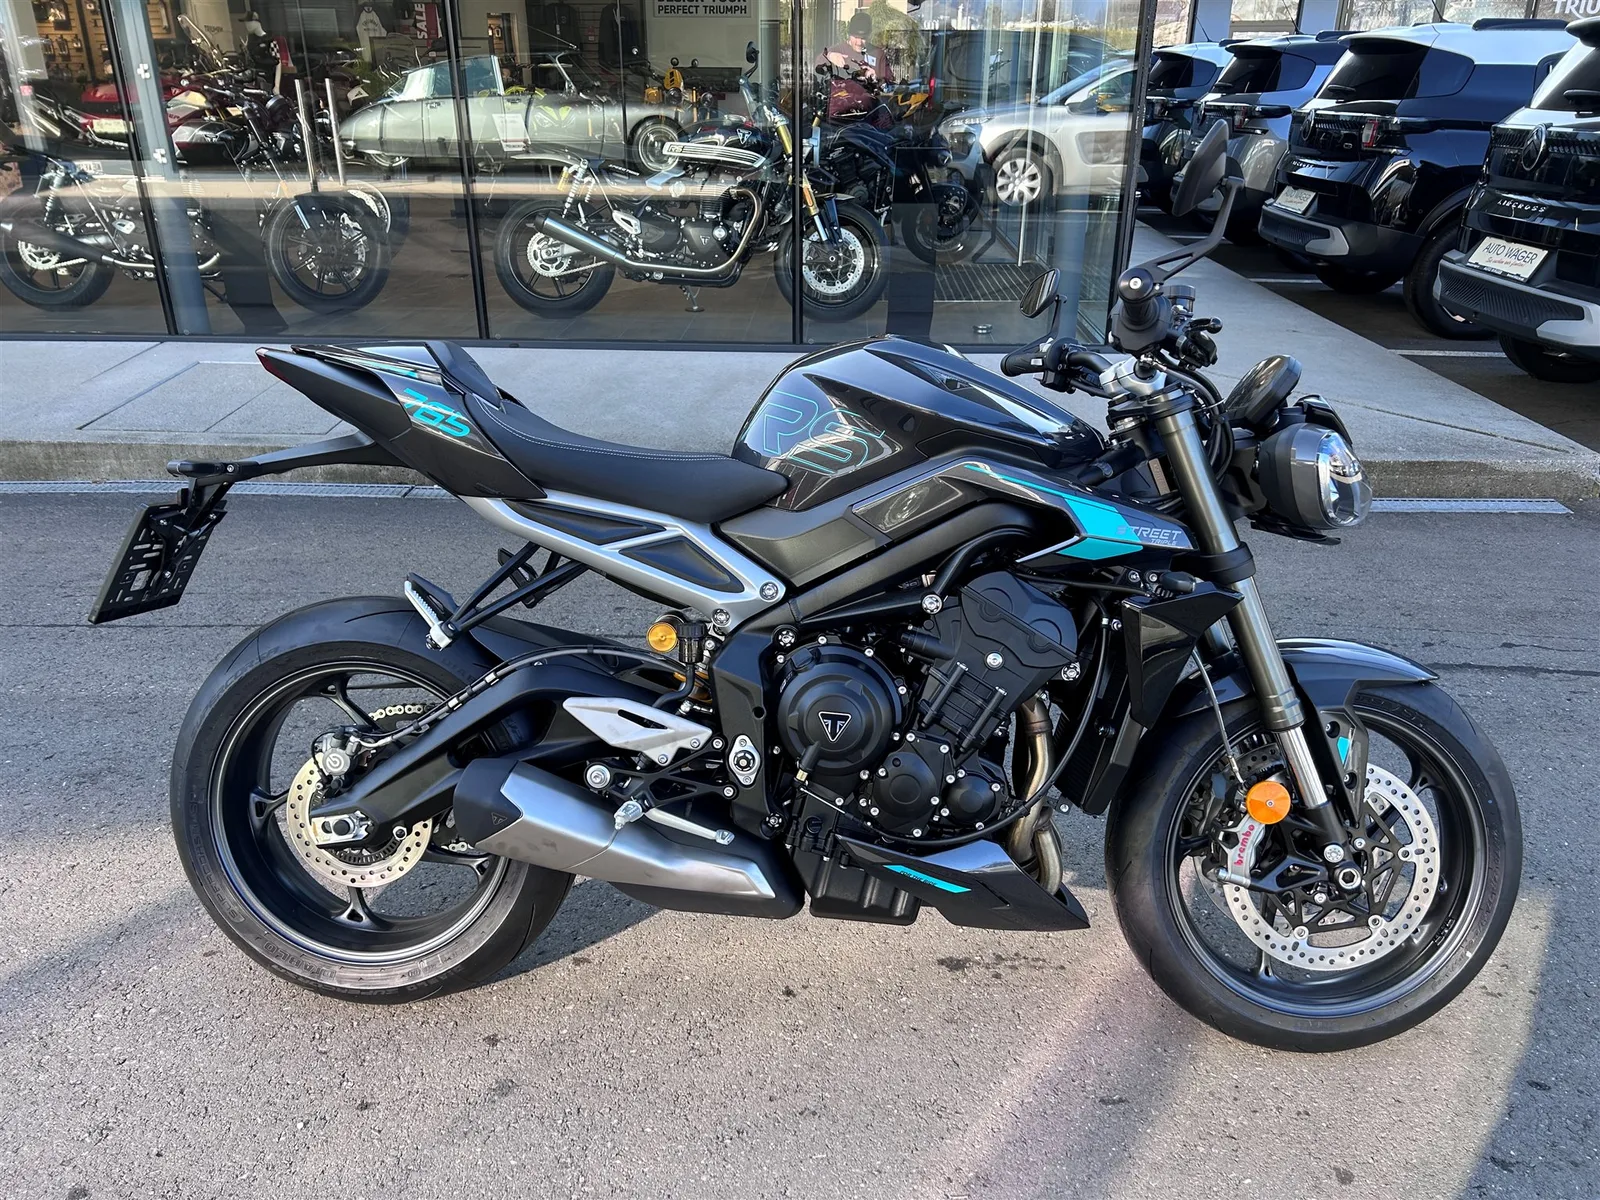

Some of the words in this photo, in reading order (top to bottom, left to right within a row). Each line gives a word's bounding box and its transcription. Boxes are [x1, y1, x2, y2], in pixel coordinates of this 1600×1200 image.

[657, 5, 700, 14] PERFECT
[703, 5, 747, 15] TRIUMPH
[415, 3, 428, 39] SALE
[1497, 199, 1546, 213] AIRCROSS
[1483, 242, 1507, 256] AUTO
[403, 387, 471, 437] 765
[741, 390, 886, 474] RS
[1116, 525, 1182, 541] STREET
[1150, 538, 1178, 546] TRIPLE
[1234, 824, 1256, 866] brembo
